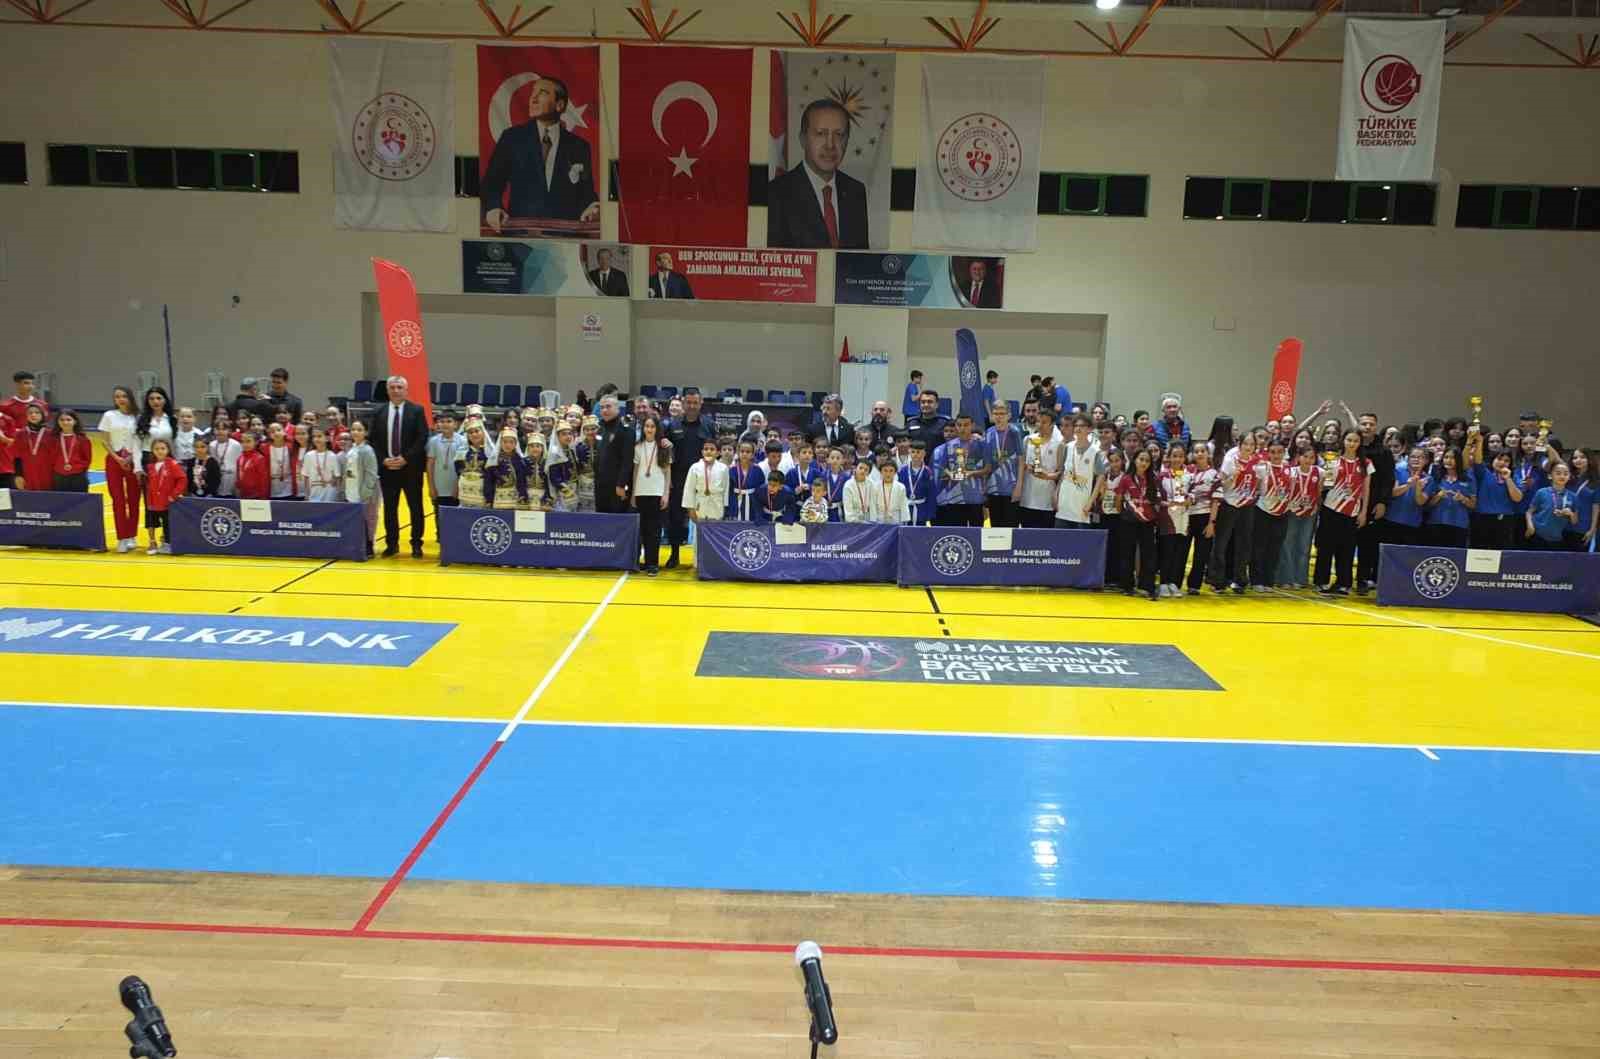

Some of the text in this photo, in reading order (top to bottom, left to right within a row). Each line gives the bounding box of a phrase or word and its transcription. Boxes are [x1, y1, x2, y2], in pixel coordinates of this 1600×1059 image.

[1358, 114, 1417, 130] TÜRKİYE
[1357, 130, 1417, 139] BASKETBOL
[1356, 139, 1417, 147] FEDERASYONU
[51, 623, 411, 651] HALKBANK
[953, 643, 1121, 657] HALKBANK
[919, 653, 1129, 666] TÜRKİYE KADINLAR
[919, 660, 1140, 676] BASKETBOL
